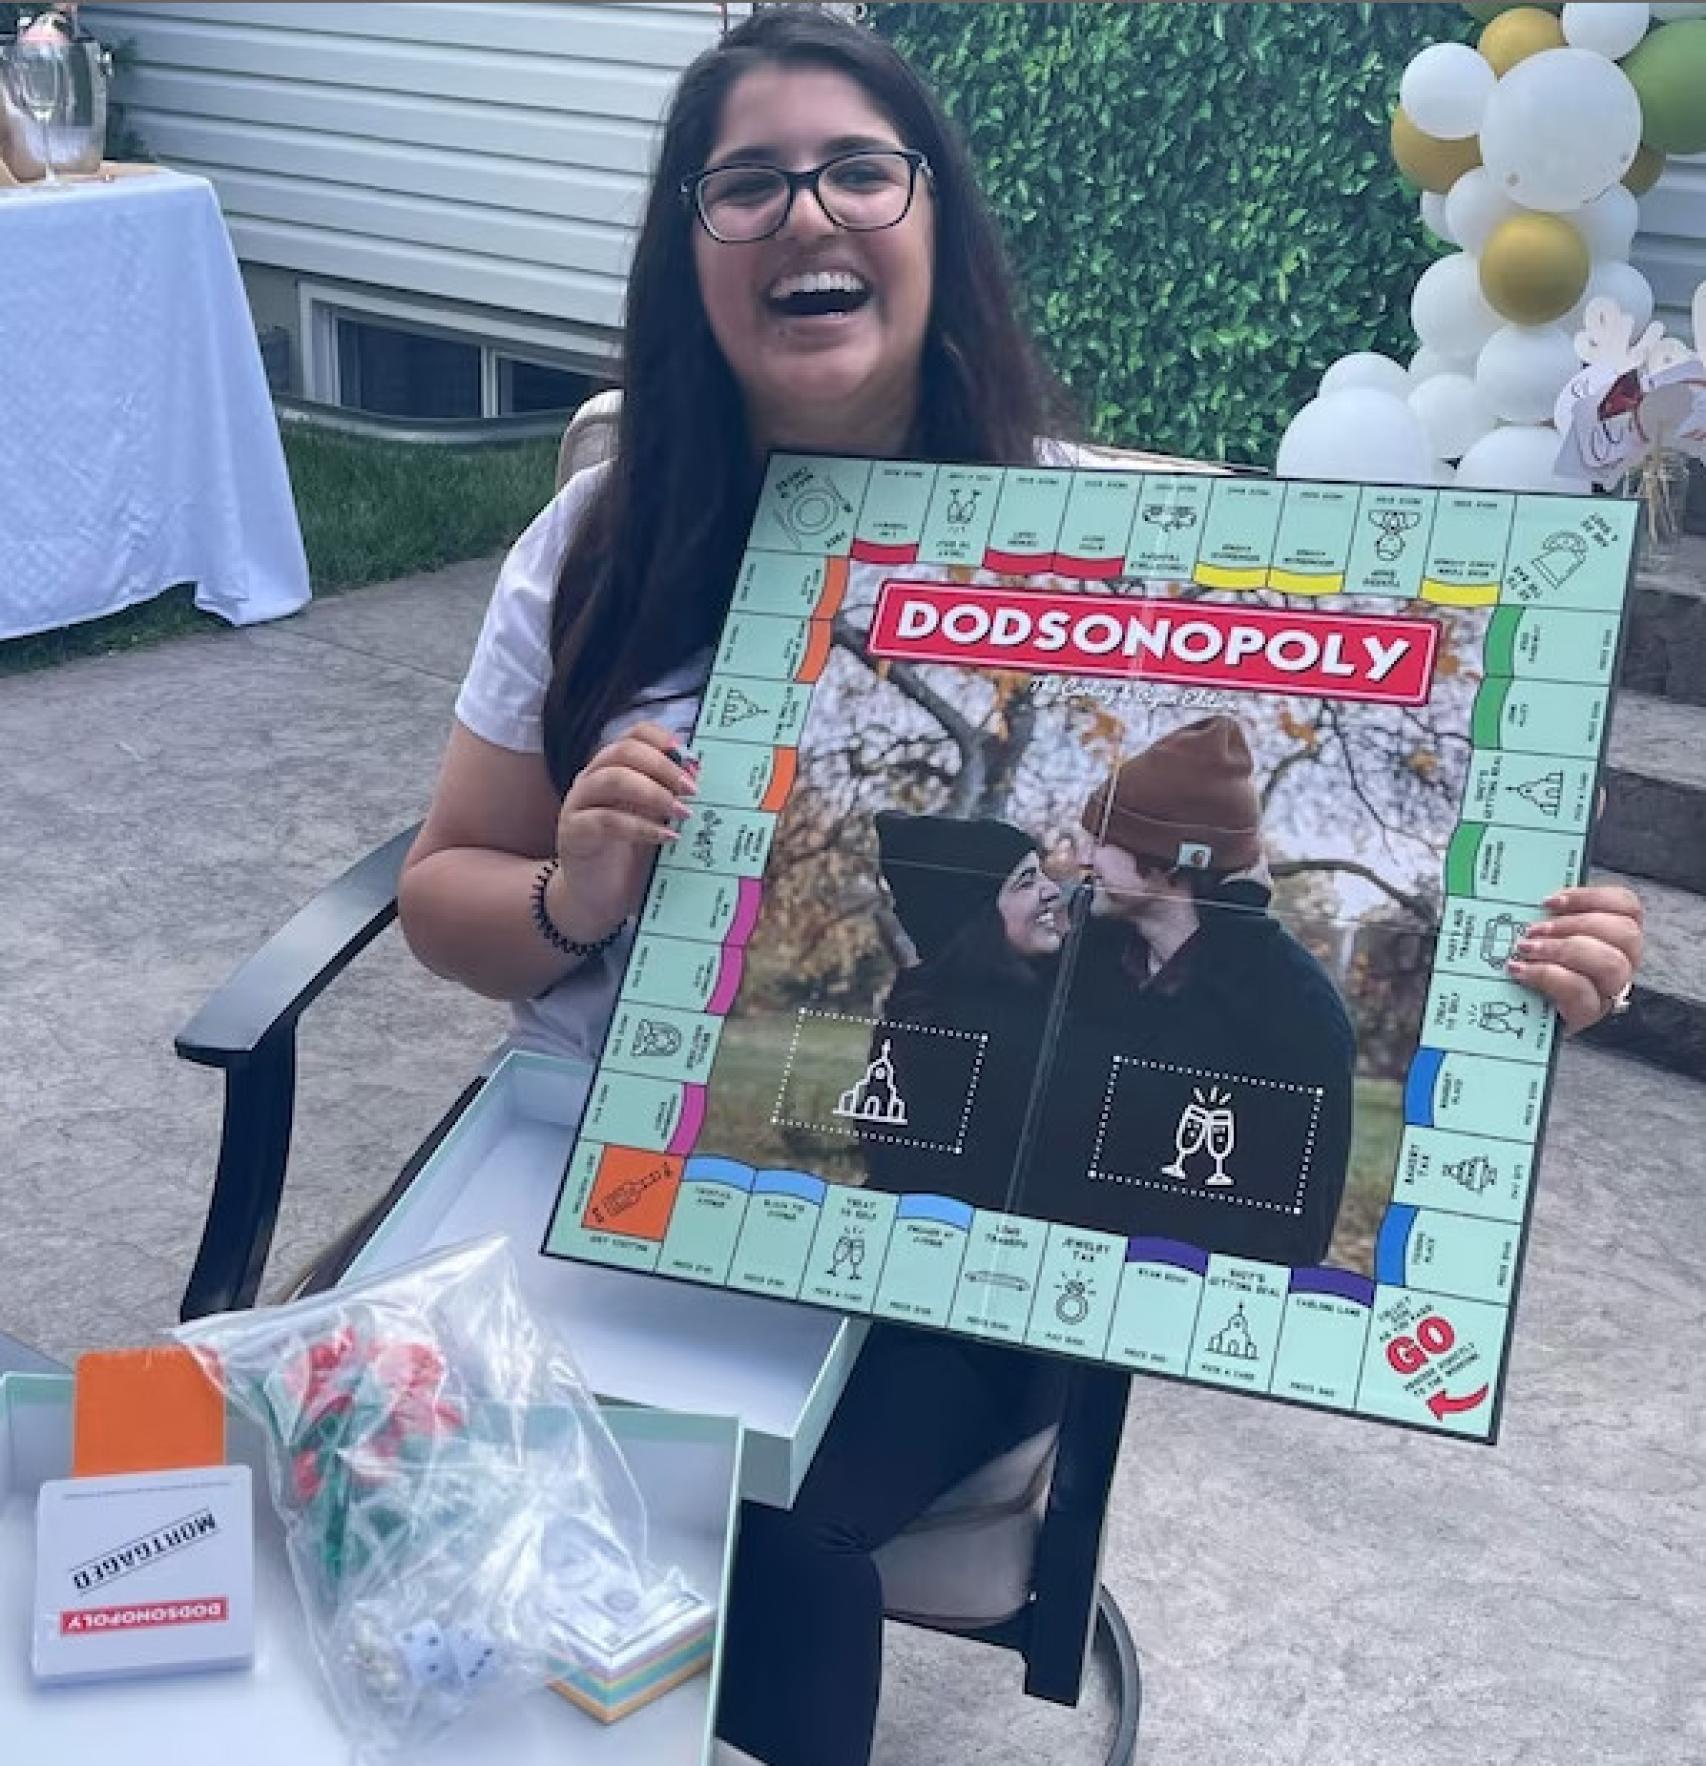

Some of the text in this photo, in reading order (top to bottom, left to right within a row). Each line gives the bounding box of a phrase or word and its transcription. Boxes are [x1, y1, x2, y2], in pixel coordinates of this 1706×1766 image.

[896, 600, 1410, 683] DODSONOPOLY
[1386, 1316, 1455, 1375] GO
[74, 1511, 216, 1589] MORTGAGED
[68, 1602, 221, 1630] DODSONOPOLY
